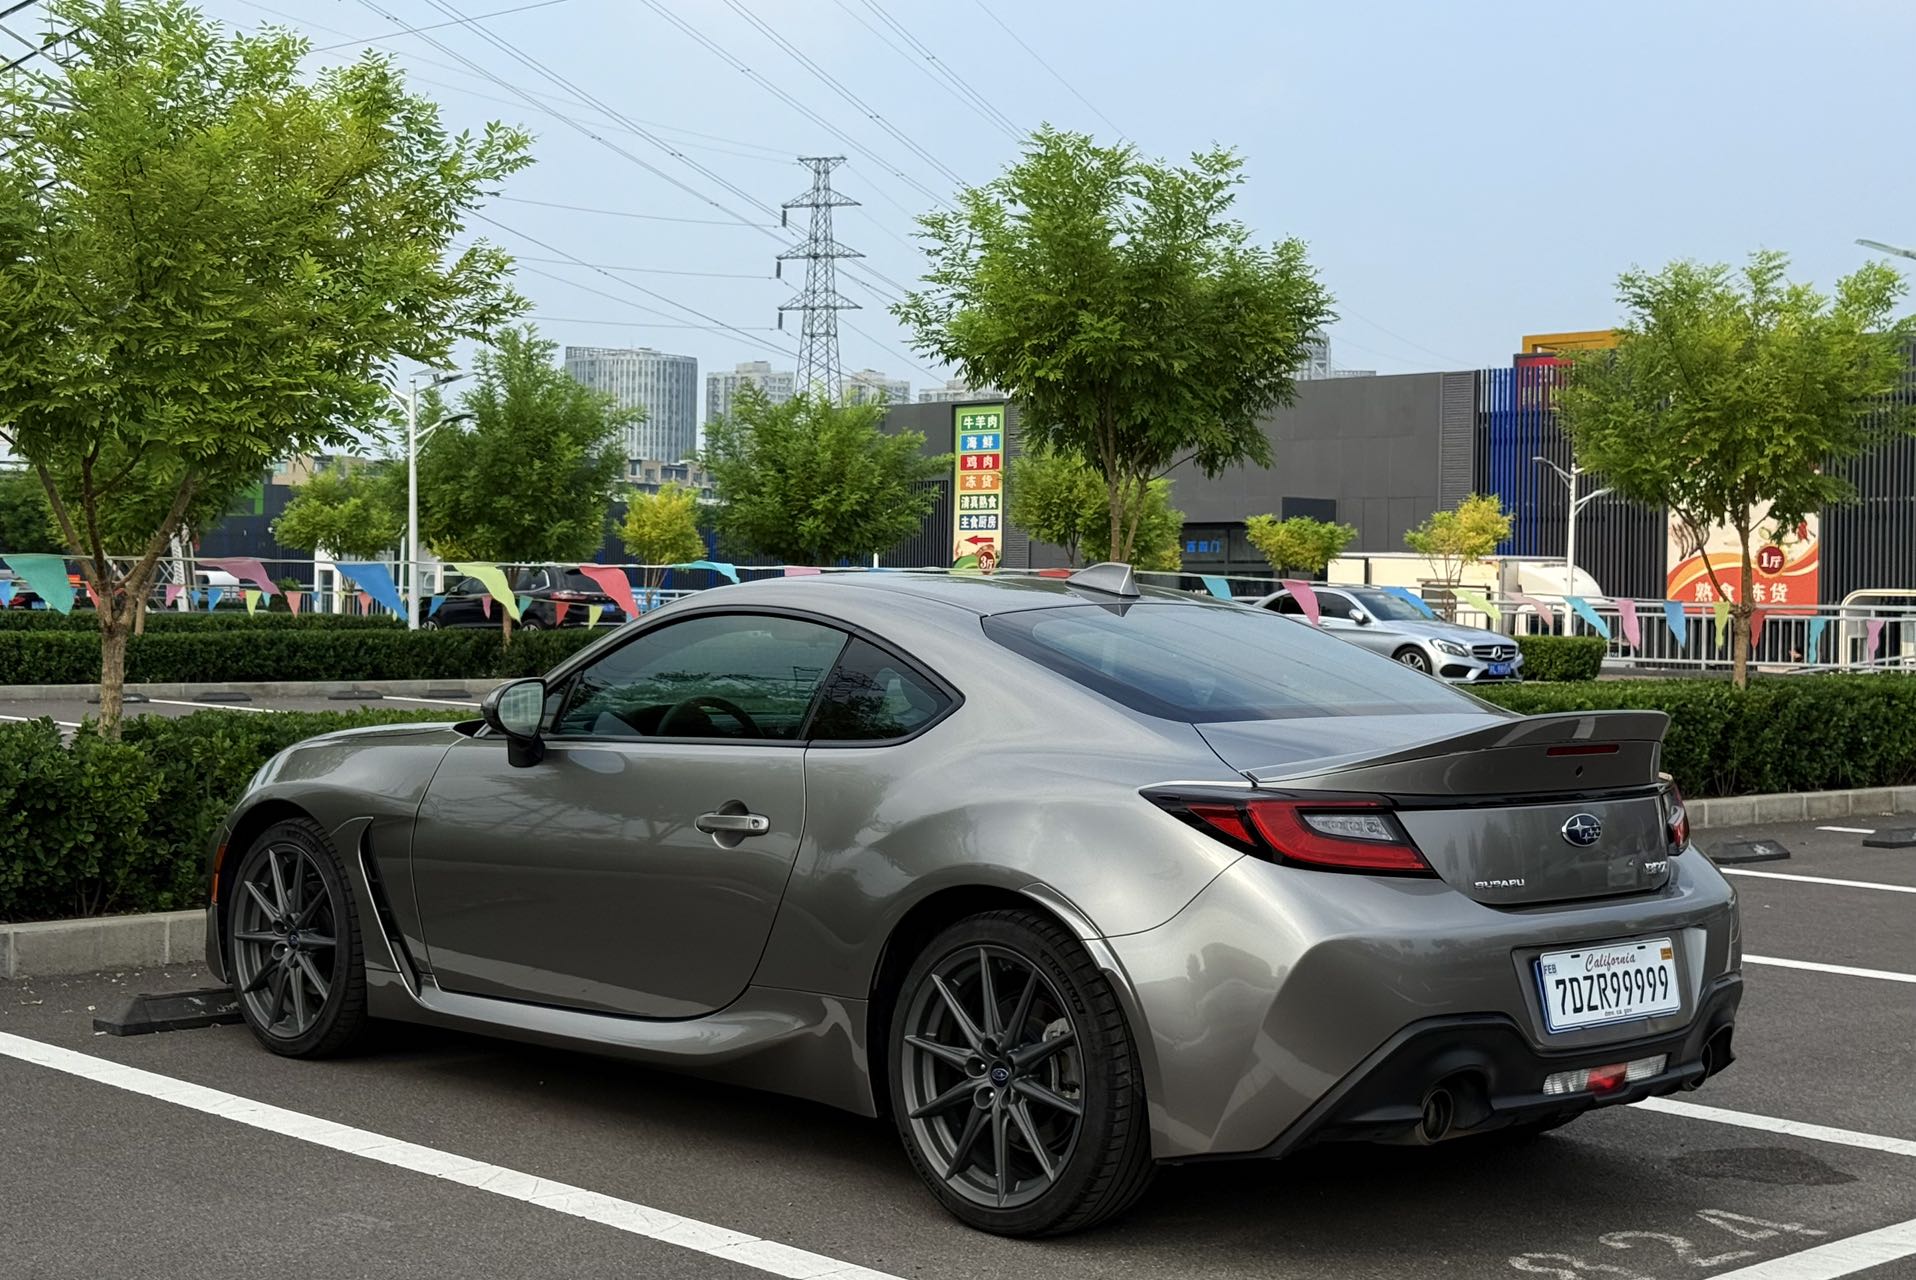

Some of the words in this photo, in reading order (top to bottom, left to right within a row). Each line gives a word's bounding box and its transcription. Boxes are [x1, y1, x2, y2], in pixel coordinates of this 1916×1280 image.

[963, 414, 998, 430] 牛羊肉
[967, 435, 994, 449] 海鲜
[966, 455, 993, 469] 鸡肉
[965, 474, 993, 489] 冻货
[961, 495, 997, 509] 清真熟食
[960, 515, 997, 529] 主食厨房
[1474, 878, 1525, 889] SUBARU
[1544, 963, 1558, 975] FEB
[1585, 952, 1636, 973] California
[1555, 964, 1669, 1016] 7DZR99999
